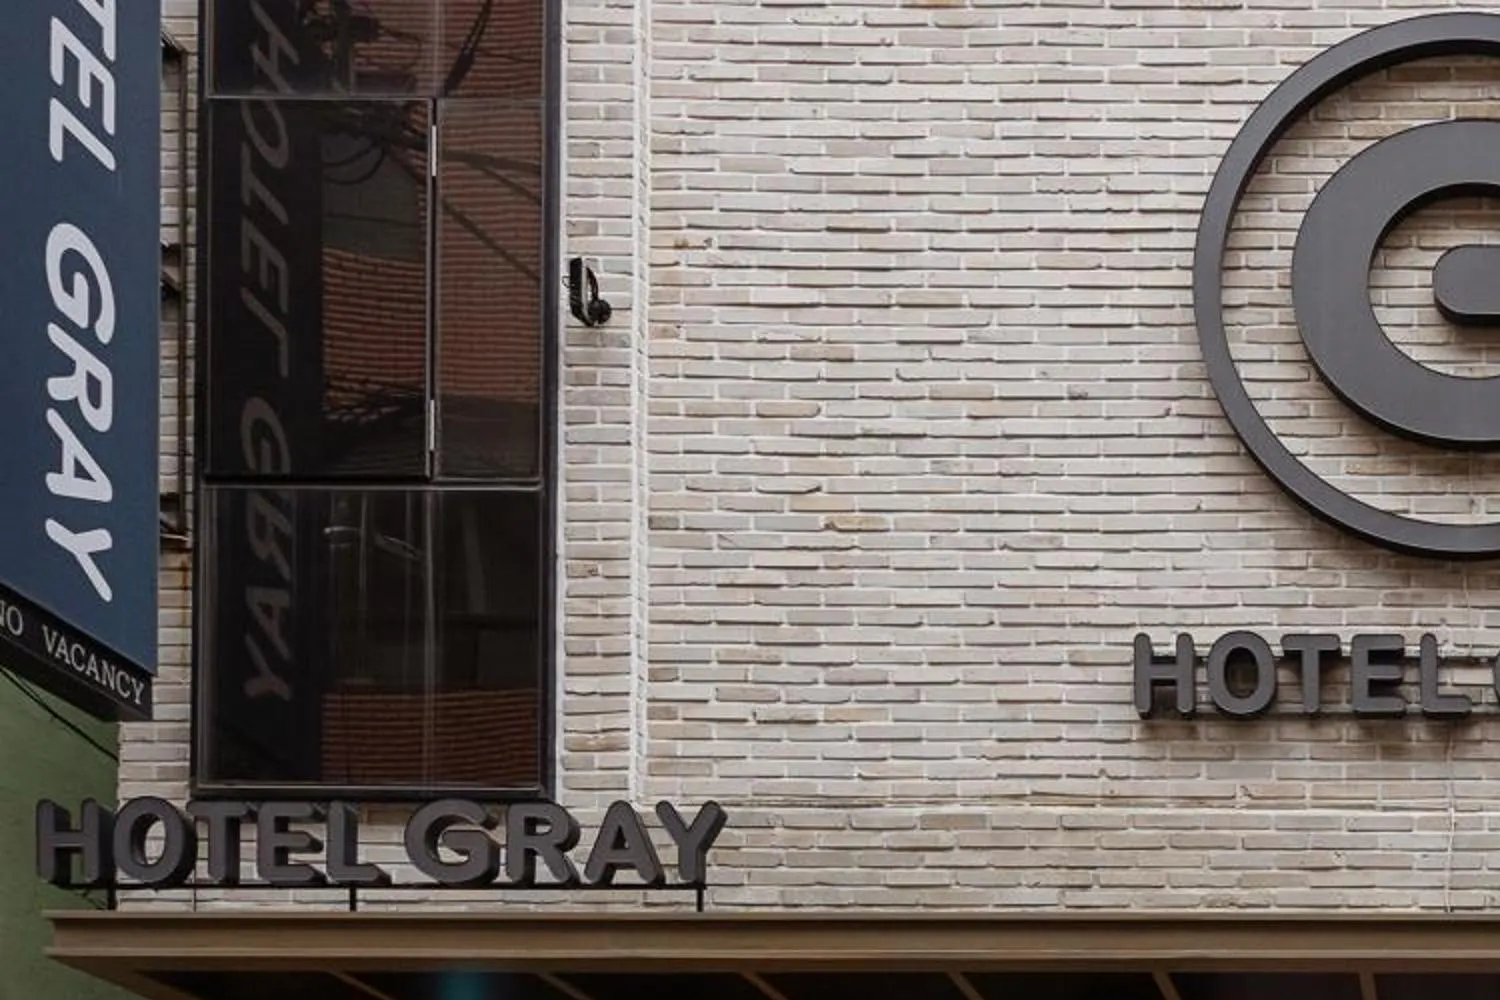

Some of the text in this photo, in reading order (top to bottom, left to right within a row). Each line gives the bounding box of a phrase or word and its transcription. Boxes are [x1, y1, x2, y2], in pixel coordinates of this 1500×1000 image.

[46, 221, 116, 602] GRAY
[42, 624, 144, 705] VACANCY
[1133, 630, 1471, 720] HOTEL
[36, 796, 728, 888] HOTEL GRAY
